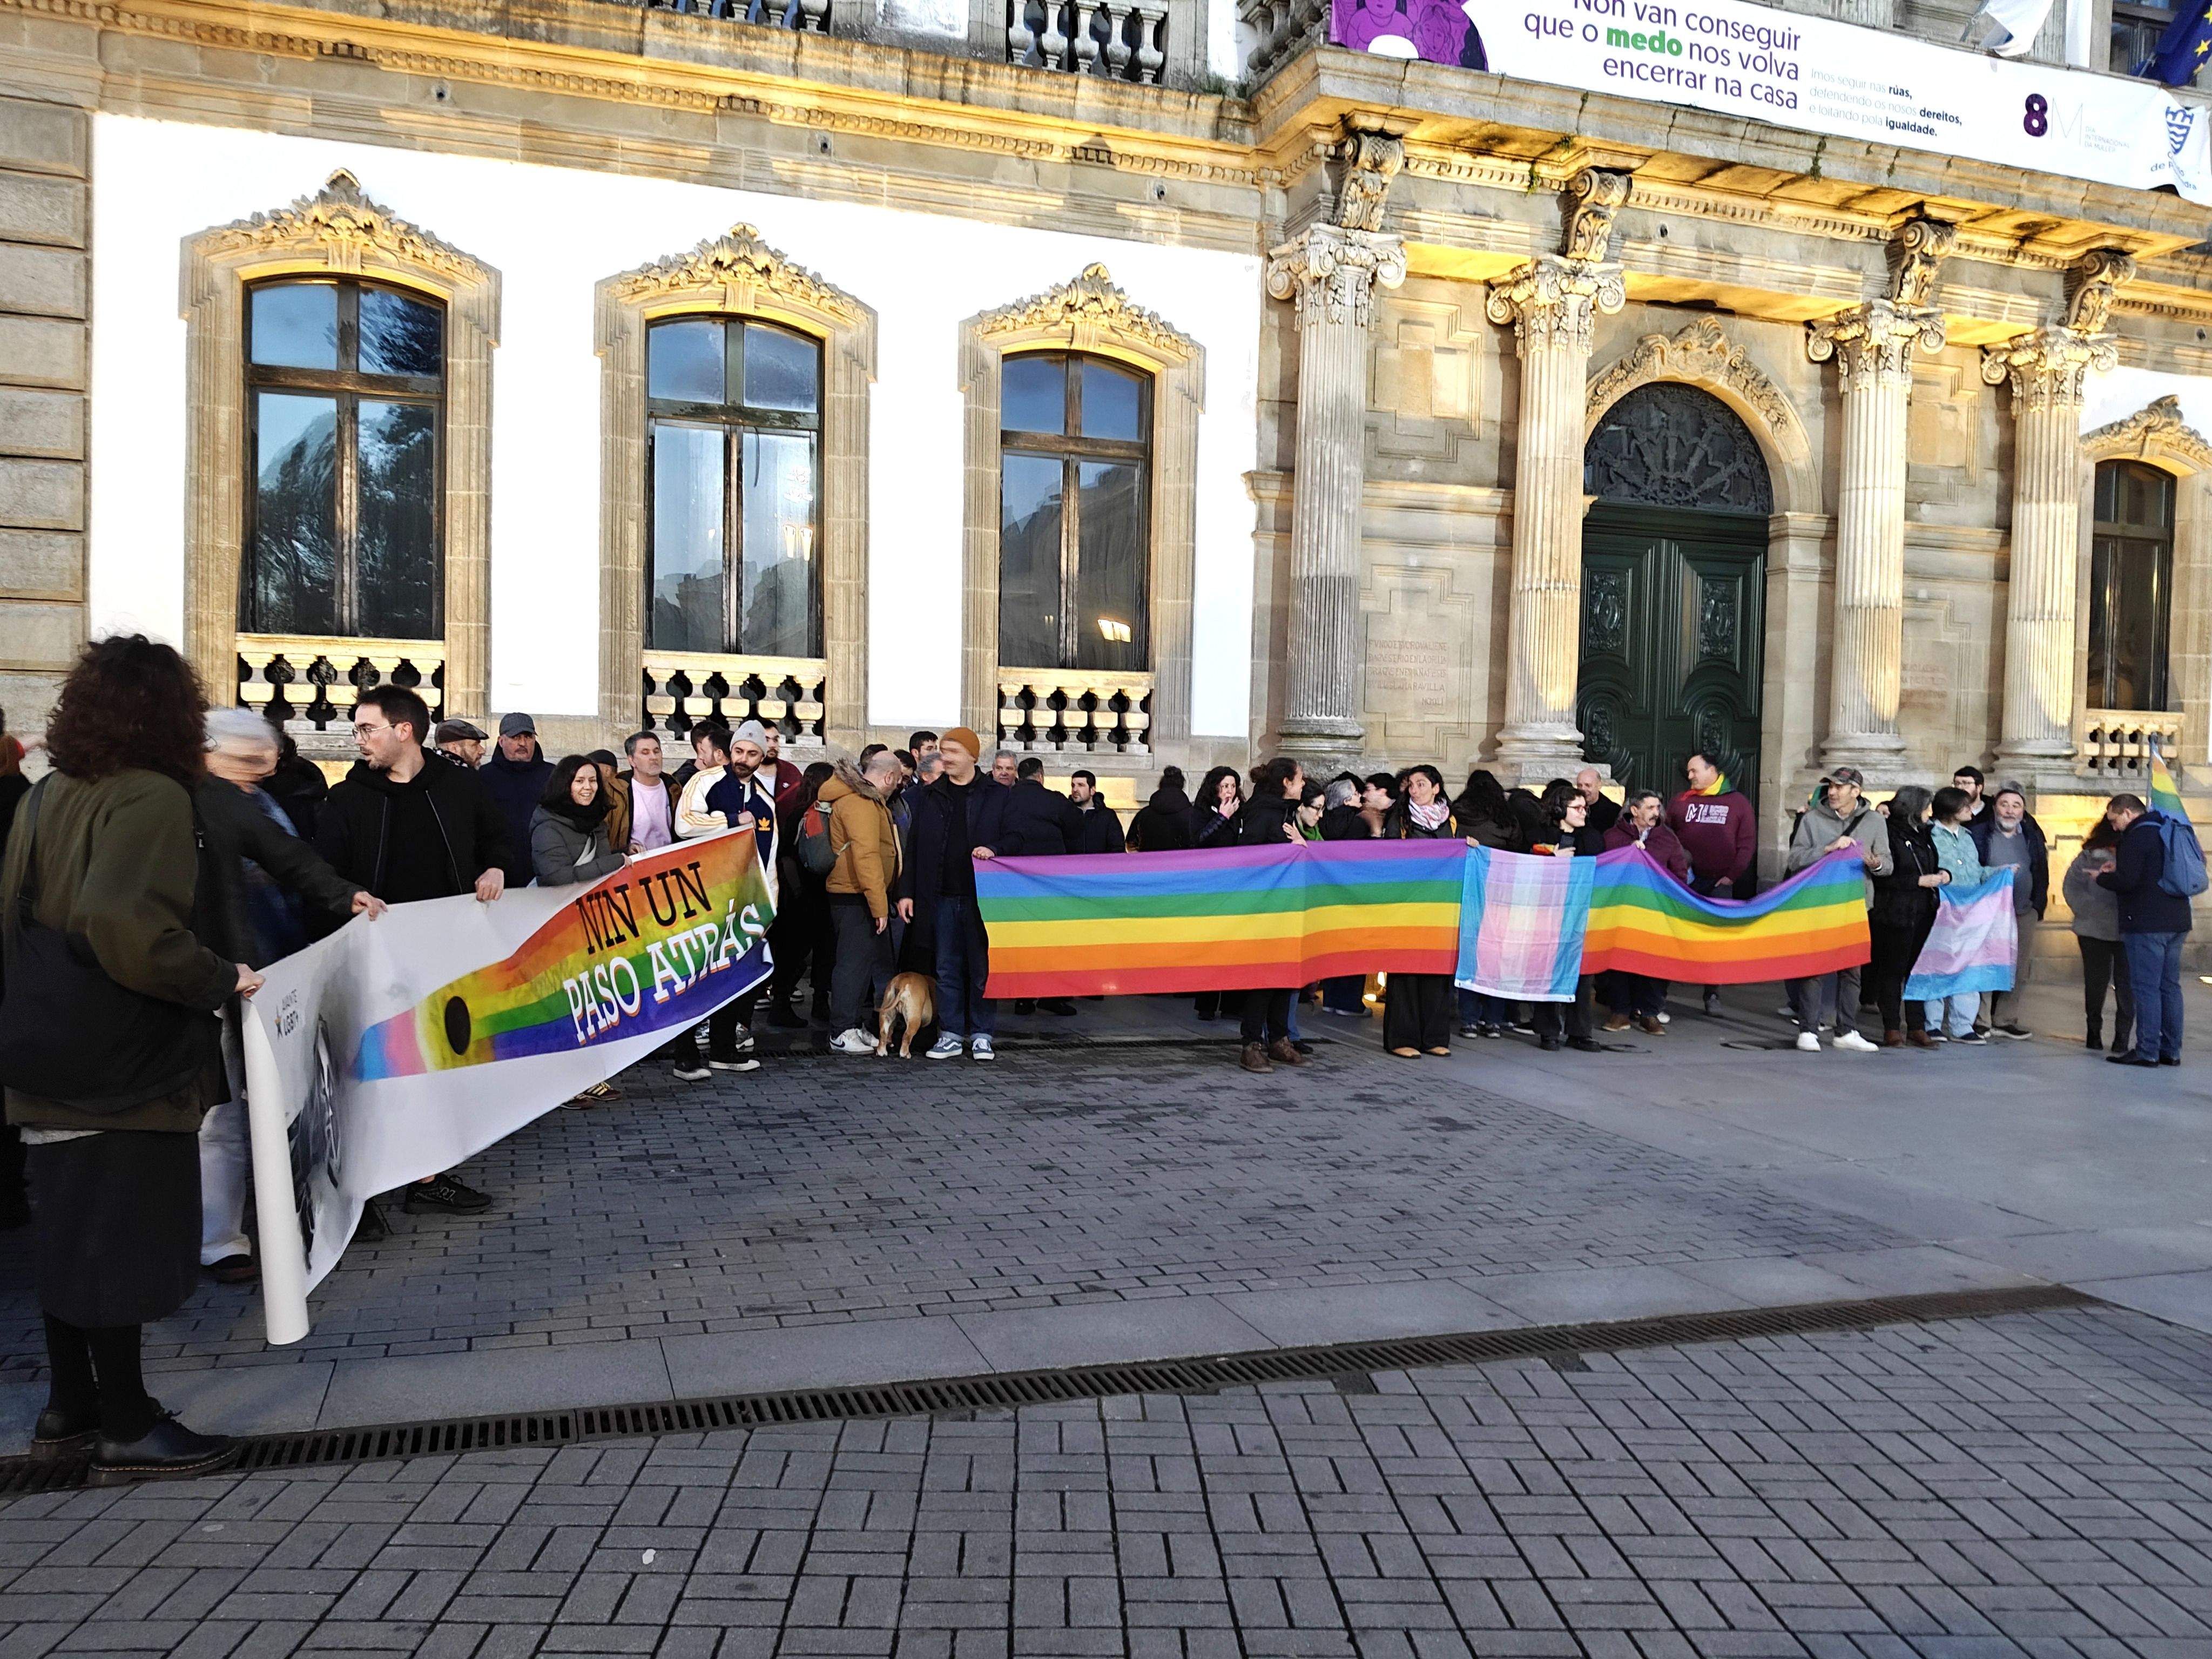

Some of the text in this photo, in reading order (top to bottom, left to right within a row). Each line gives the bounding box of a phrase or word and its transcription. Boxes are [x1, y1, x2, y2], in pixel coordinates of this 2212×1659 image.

[1524, 13, 1798, 81] que o medo nos volva
[1634, 2, 1677, 27] van
[1685, 12, 1801, 51] conseguir
[1603, 58, 1798, 110] encerrar na casa
[1811, 68, 1835, 83] Imos
[1837, 76, 1866, 89] seguir
[1870, 82, 1886, 93] nas
[1809, 104, 1937, 137] e loitando pola igualdade.
[1810, 86, 1963, 126] defendendo os nosos dereitos,
[575, 861, 712, 955] NIN UN
[562, 898, 765, 1046] PASO ATRÁS
